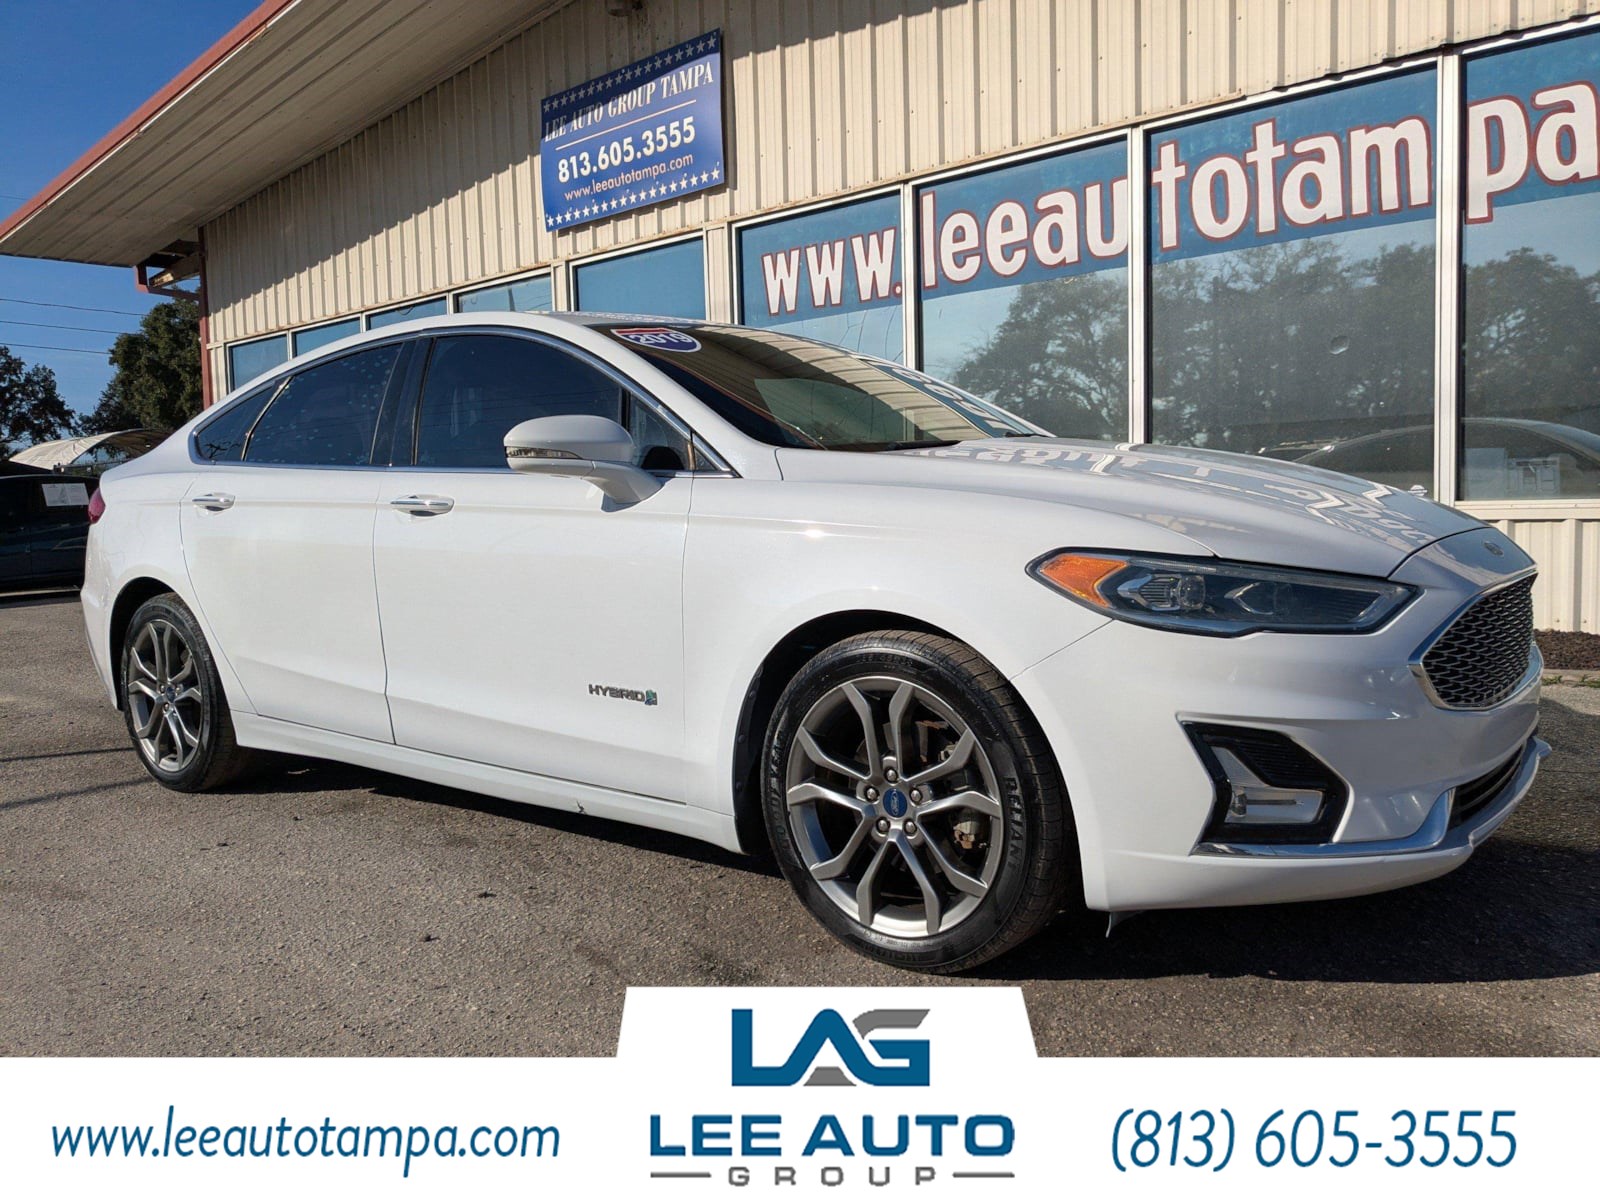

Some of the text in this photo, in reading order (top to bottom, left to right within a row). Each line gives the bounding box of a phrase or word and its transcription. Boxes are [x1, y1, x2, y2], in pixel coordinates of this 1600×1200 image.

[544, 61, 714, 142] LEE AUTO GROUP TAMPA
[558, 116, 696, 183] 813.605.3555
[564, 153, 694, 201] www.leeautotampa.com
[629, 333, 693, 343] 2019
[588, 684, 645, 702] HYBRID
